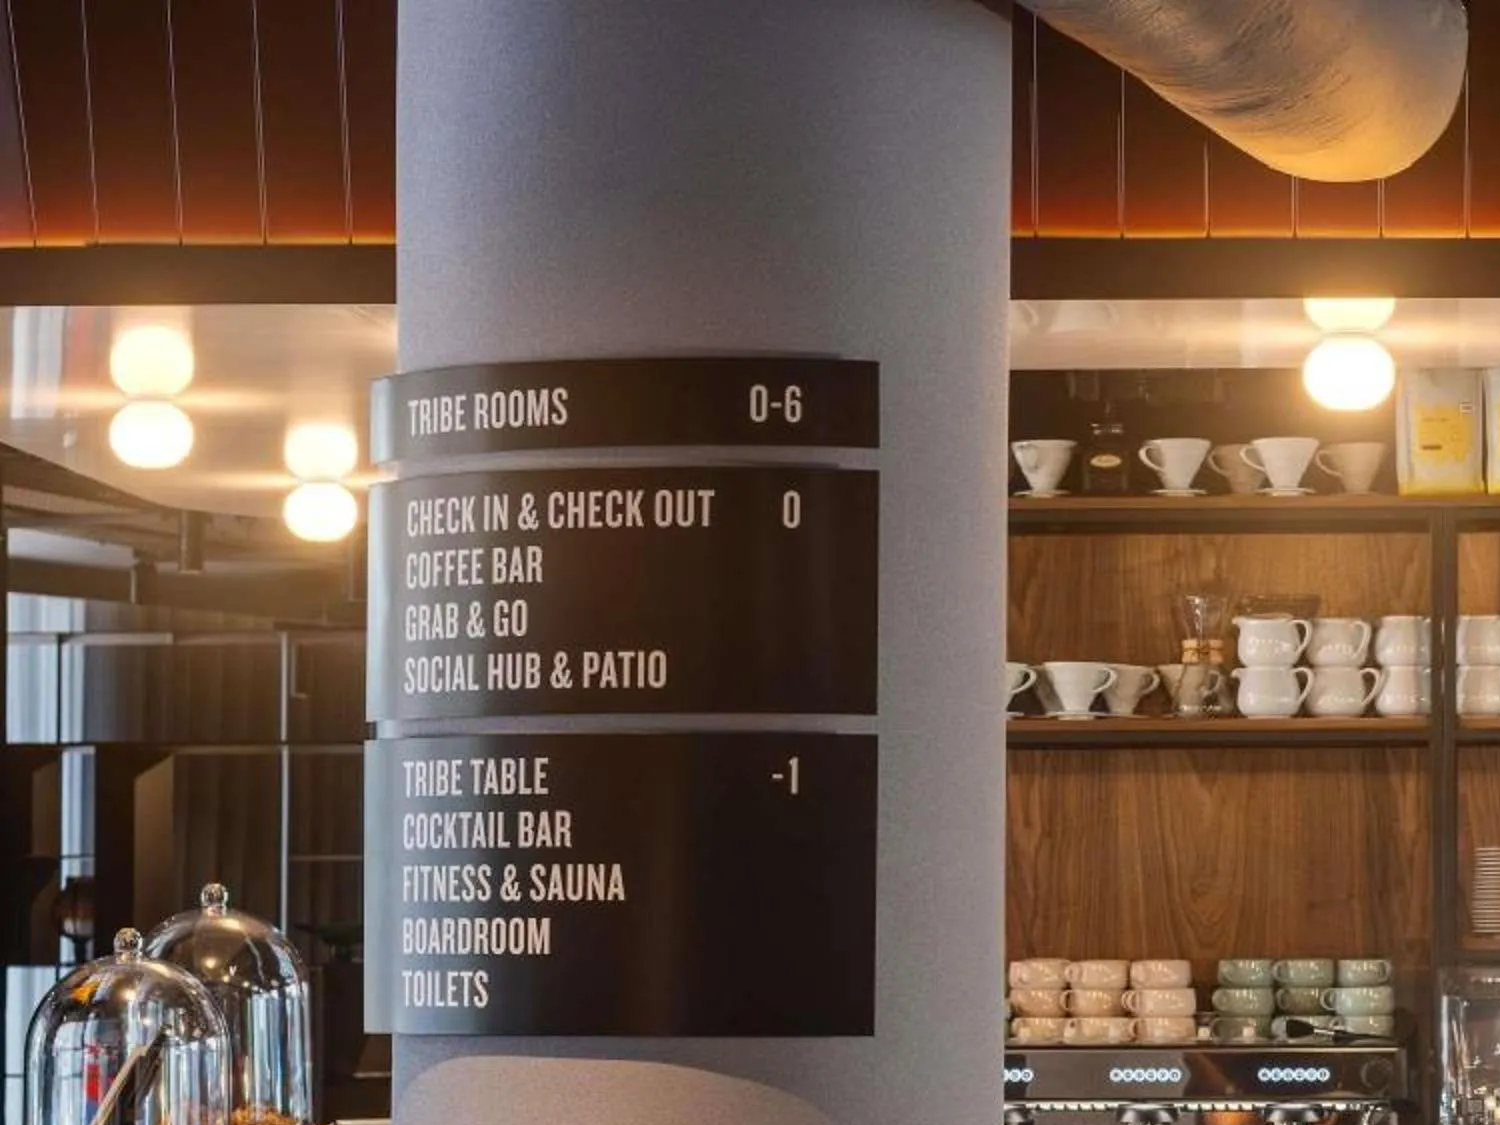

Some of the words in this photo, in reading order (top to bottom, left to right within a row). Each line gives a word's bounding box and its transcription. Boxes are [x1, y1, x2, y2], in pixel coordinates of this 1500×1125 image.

[407, 395, 466, 437] TRIBE
[473, 387, 568, 431] ROOMS
[750, 384, 802, 423] 0-6
[406, 495, 475, 538] CHECK
[483, 494, 509, 532] IN
[517, 492, 539, 531] &
[547, 489, 644, 529] CHECK
[654, 489, 715, 528] OUT
[783, 490, 801, 529] 0
[405, 548, 484, 590] COFFEE
[492, 545, 543, 585] BAR
[405, 603, 459, 642] GRAB
[466, 600, 486, 639] &
[493, 599, 528, 637] GO
[403, 655, 479, 695] SOCIAL
[487, 652, 541, 691] HUB
[549, 651, 573, 689] &
[583, 650, 667, 689] PATIO
[402, 759, 463, 797] TRIBE
[469, 757, 549, 796] TABLE
[772, 757, 799, 795] -1
[402, 810, 510, 850] COCKTAIL
[518, 810, 572, 848] BAR
[402, 863, 491, 903] FITNESS
[499, 863, 522, 902] &
[529, 863, 625, 902] SAUNA
[402, 915, 551, 957] BOARDROOM
[402, 968, 489, 1010] TOILETS
